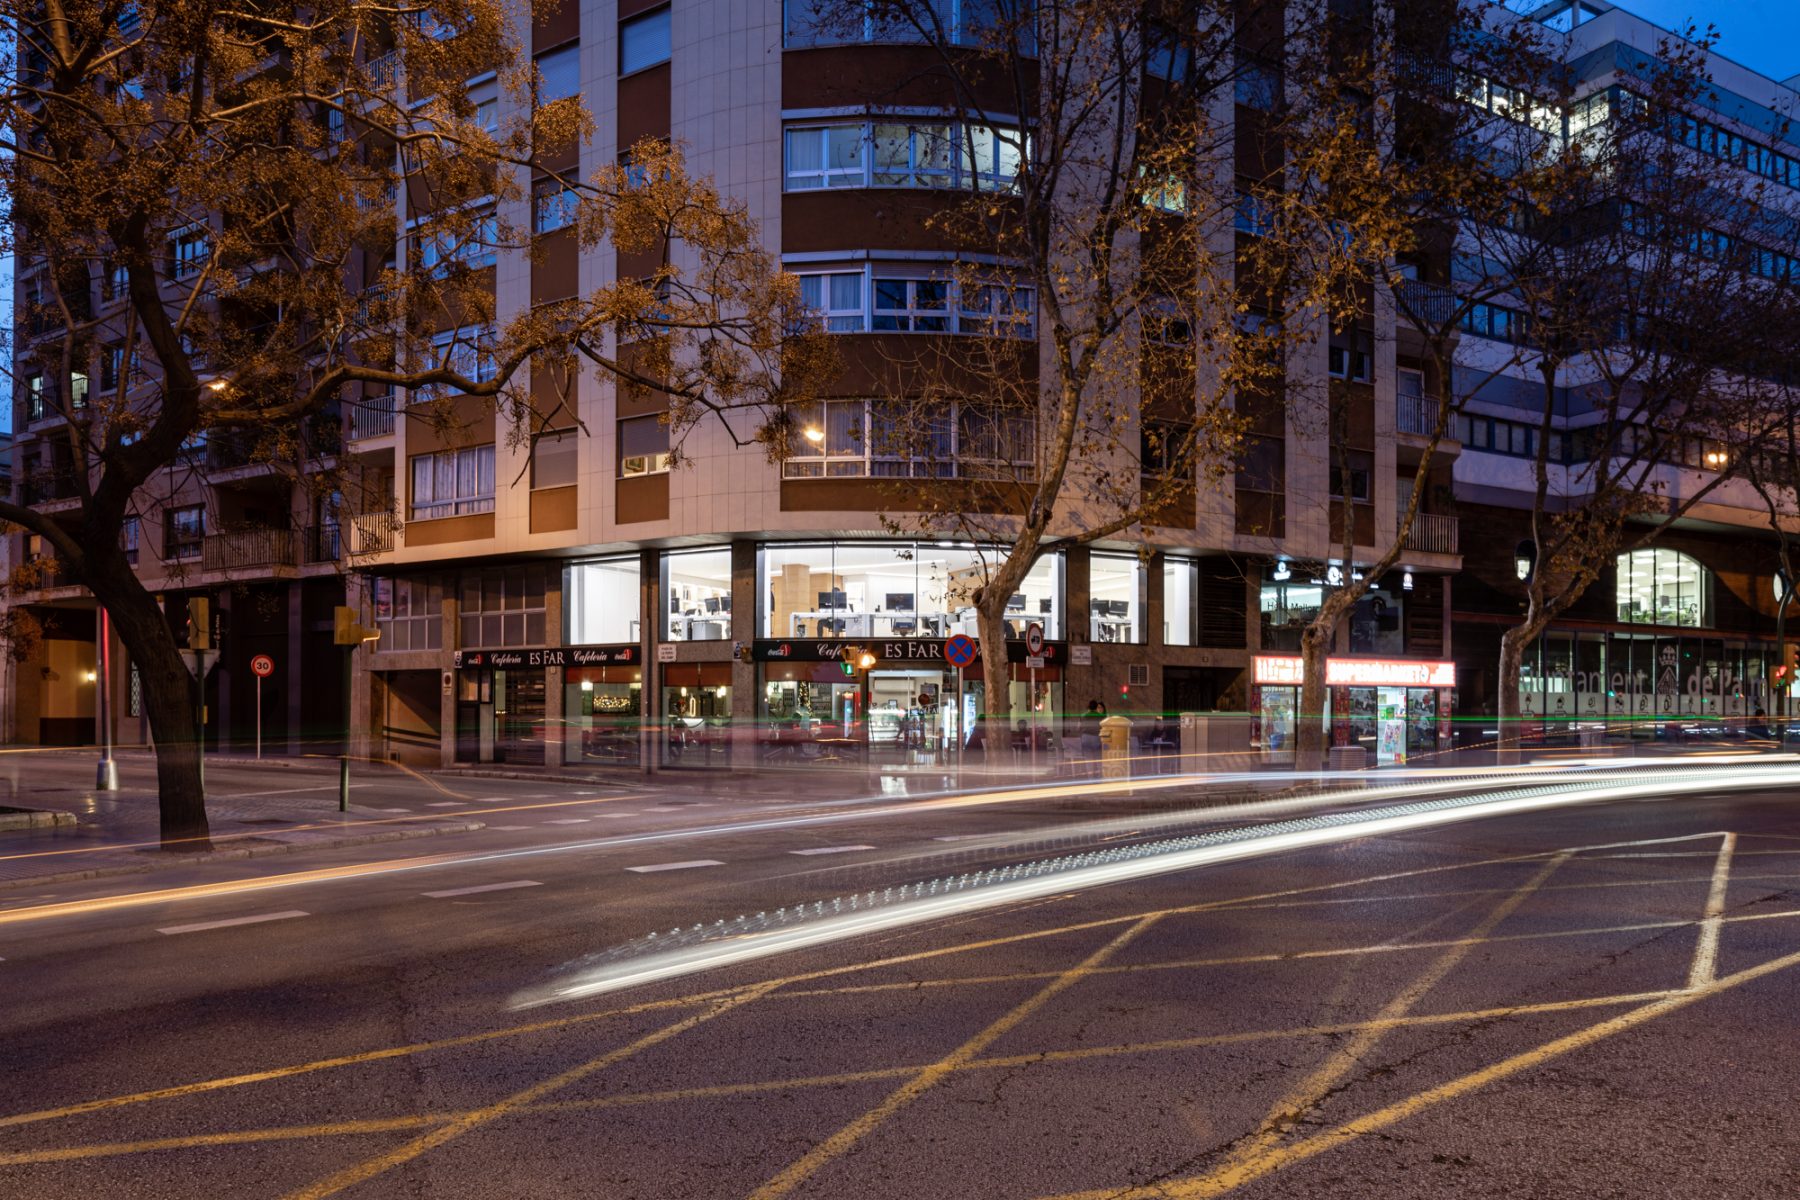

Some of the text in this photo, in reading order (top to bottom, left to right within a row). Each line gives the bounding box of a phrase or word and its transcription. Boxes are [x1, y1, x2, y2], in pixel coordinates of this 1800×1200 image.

[529, 649, 566, 665] ES FAR
[885, 641, 942, 658] ES FAR
[256, 662, 269, 670] 30
[1687, 665, 1714, 696] de
